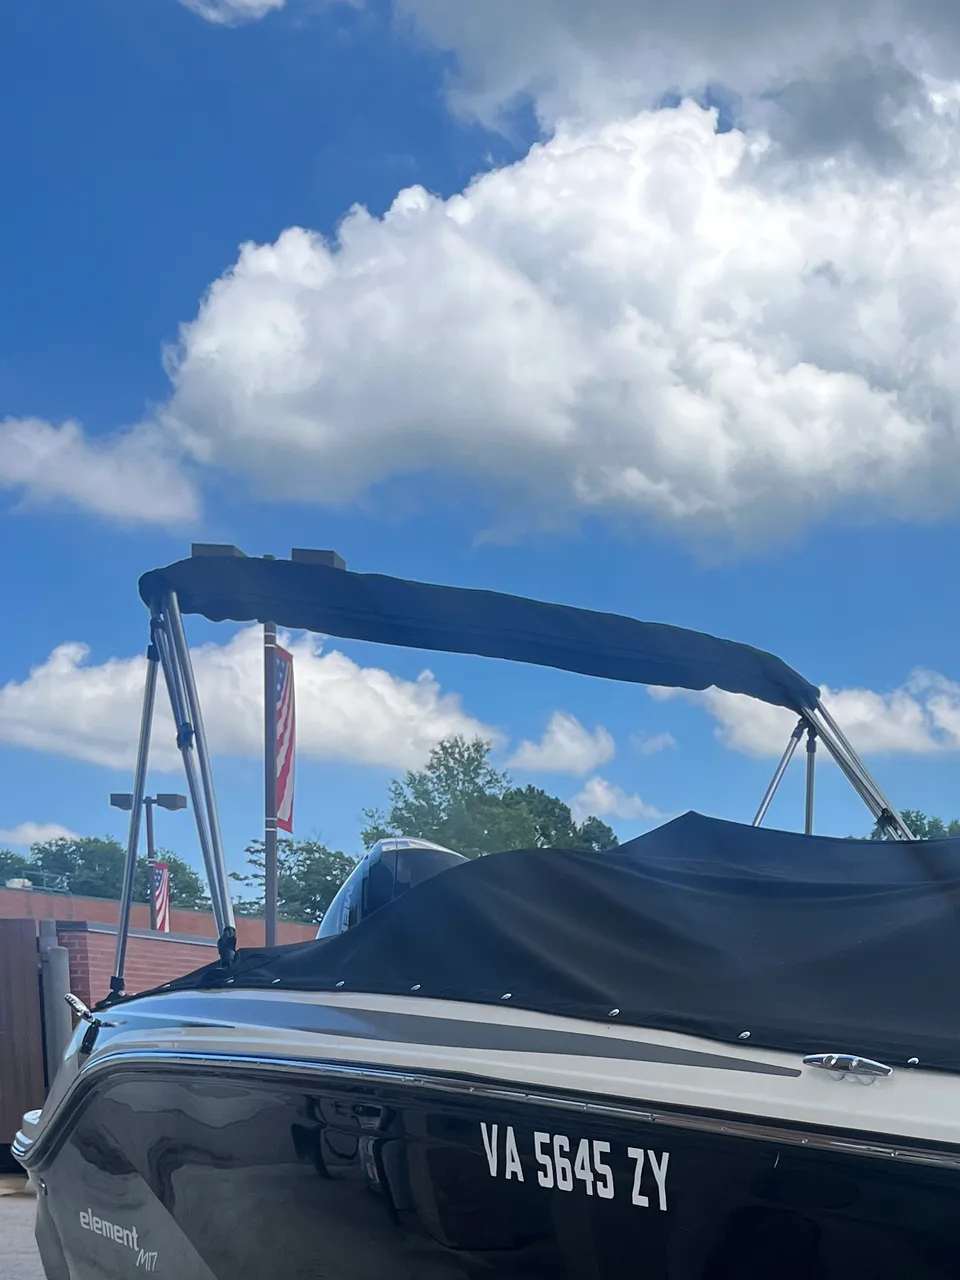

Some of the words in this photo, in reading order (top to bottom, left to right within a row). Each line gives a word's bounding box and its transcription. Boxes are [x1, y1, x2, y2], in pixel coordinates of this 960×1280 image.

[480, 1122, 525, 1182] VA
[533, 1131, 615, 1200] 5645
[627, 1147, 670, 1211] ZY
[80, 1207, 140, 1251] element
